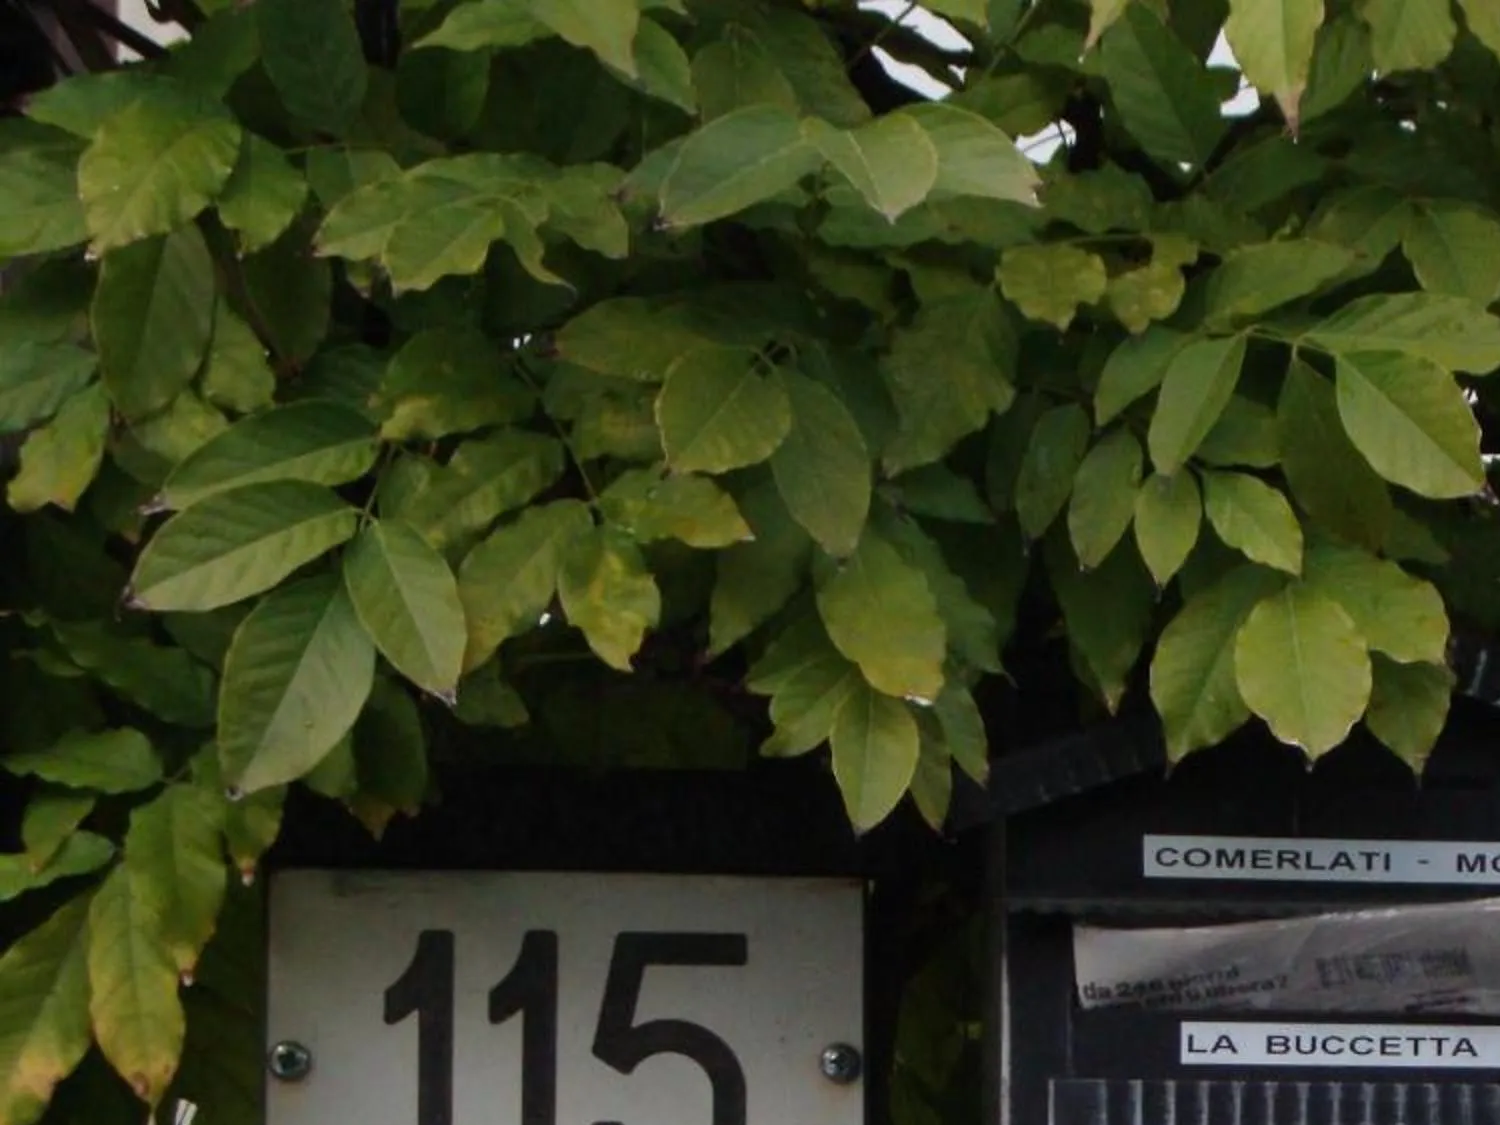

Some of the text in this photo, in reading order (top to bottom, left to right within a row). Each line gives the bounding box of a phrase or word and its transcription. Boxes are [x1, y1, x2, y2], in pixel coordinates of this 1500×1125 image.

[1154, 846, 1392, 872] COMERLATI
[1186, 1033, 1237, 1055] LA
[1267, 1034, 1478, 1058] BUCCETTA
